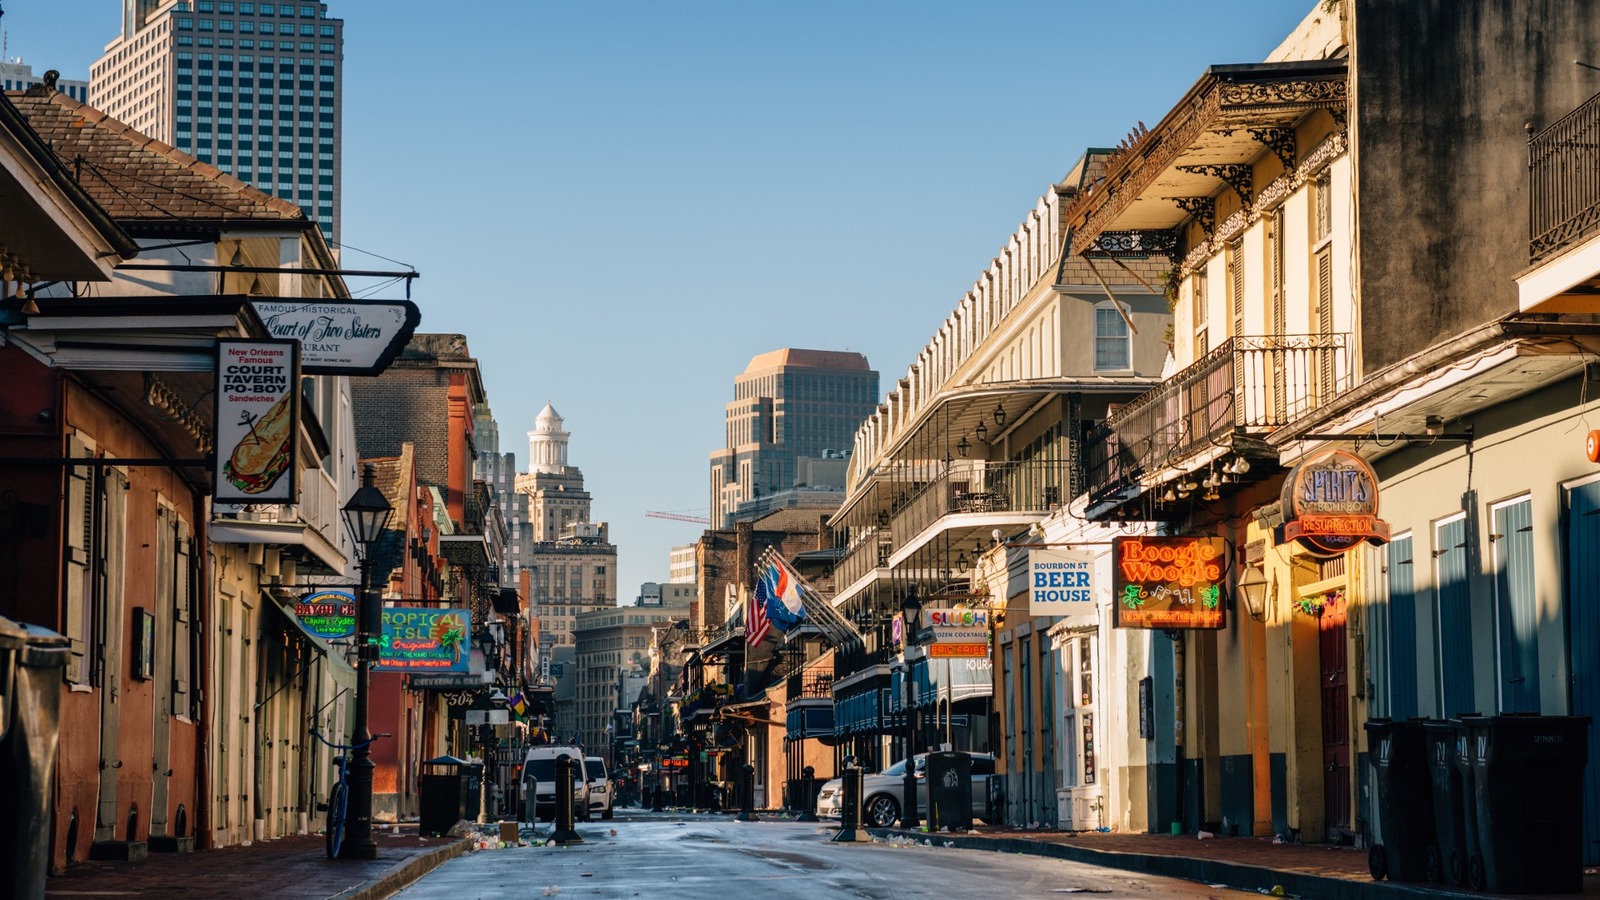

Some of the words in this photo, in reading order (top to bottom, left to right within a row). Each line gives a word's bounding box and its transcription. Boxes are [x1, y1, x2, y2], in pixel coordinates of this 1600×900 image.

[258, 304, 297, 313] FAMOUS
[302, 306, 358, 314] HISTORICAL
[265, 314, 298, 336] Court
[300, 320, 315, 340] of
[313, 316, 343, 342] Two
[344, 316, 382, 340] Sisters
[250, 348, 284, 357] Orleans
[302, 344, 340, 352] URANT
[226, 366, 284, 375] COURT
[223, 375, 286, 384] TAVERN
[224, 384, 287, 394] PO-BOY
[1304, 470, 1368, 502] SPIRITS
[1318, 502, 1372, 512] BOURBON
[1303, 519, 1372, 531] RESURRECTION
[1122, 540, 1216, 568] Boogie
[1034, 572, 1090, 588] BEER
[1122, 562, 1220, 587] Woogie
[1034, 590, 1090, 602] HOUSE
[295, 603, 334, 616] BAYOU
[339, 604, 356, 616] CL
[304, 616, 325, 626] Cajun
[333, 616, 356, 626] Zydec
[381, 612, 464, 626] ROPICAL
[931, 612, 986, 626] SLUSH
[392, 627, 440, 640] ISLE
[392, 640, 436, 651] Original
[956, 646, 986, 654] FRIES
[449, 692, 474, 706] 504
